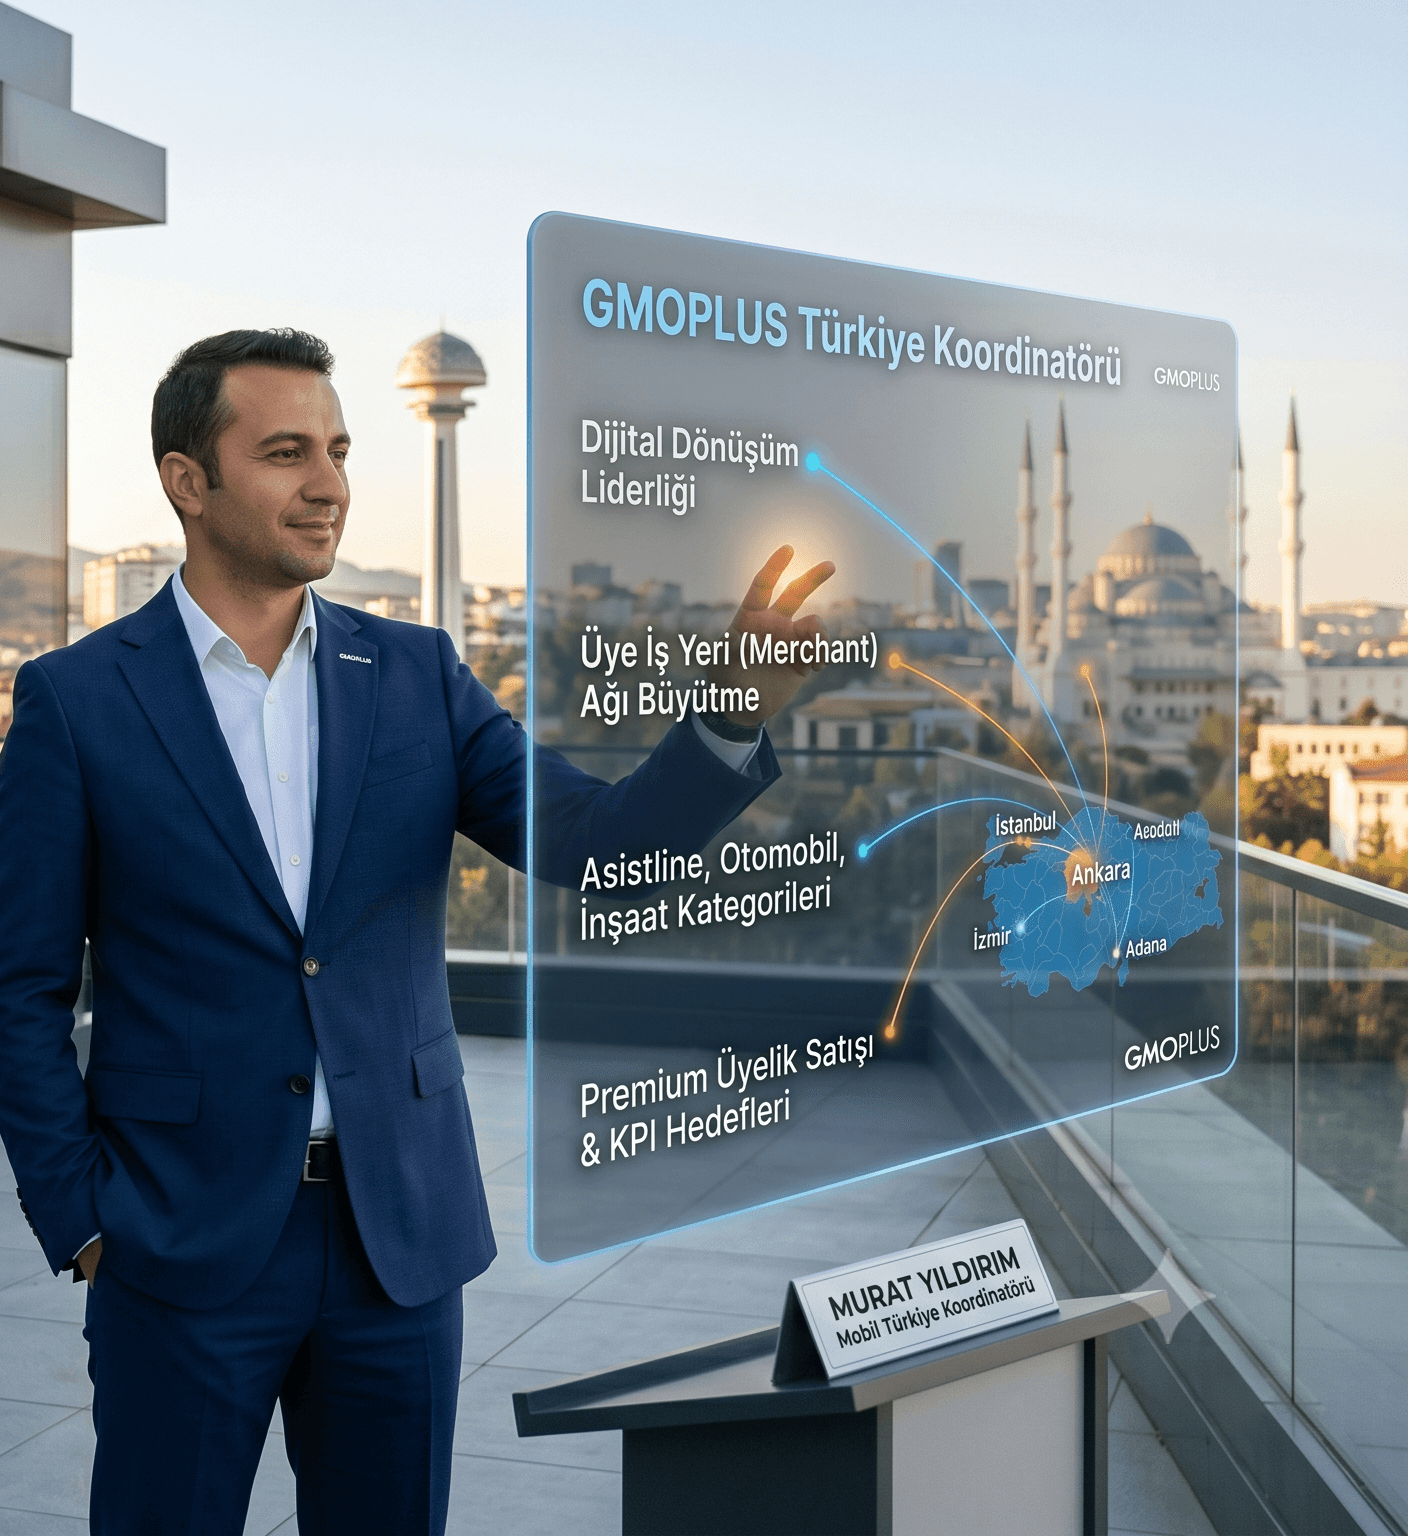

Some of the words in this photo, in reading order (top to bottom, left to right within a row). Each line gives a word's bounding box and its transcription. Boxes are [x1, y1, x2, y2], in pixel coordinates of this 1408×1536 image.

[583, 278, 788, 348] GMOPLUS
[798, 305, 924, 370] Türkiye
[934, 326, 1121, 386] Koordinatörü
[1154, 368, 1220, 392] GMOPLUS
[582, 420, 663, 463] Dijital
[673, 426, 800, 473] Dönüşüm
[582, 469, 696, 516] Liderliği
[581, 626, 637, 676] Üye
[646, 626, 670, 675] İş
[678, 632, 730, 666] Yeri
[740, 631, 878, 670] (Merchant)
[581, 682, 629, 726] Ağı
[639, 680, 760, 722] Büyütme
[996, 811, 1056, 836] İstanbul
[580, 846, 711, 891] Asistline,
[720, 832, 846, 873] Otomobil,
[1072, 862, 1130, 886] Ankara
[580, 898, 669, 946] İnşaat
[678, 879, 831, 932] Kategorileri
[974, 926, 1011, 950] İzmir
[1125, 939, 1167, 958] Adana
[1124, 1026, 1221, 1071] GMOPLUS
[581, 1062, 708, 1118] Premium
[717, 1045, 797, 1098] Üyelik
[806, 1034, 874, 1069] Satışı
[580, 1132, 601, 1168] &
[610, 1120, 657, 1162] KPI
[666, 1090, 790, 1148] Hedefleri
[828, 1275, 913, 1321] MURAT
[917, 1247, 1020, 1293] YILDIRIM
[836, 1318, 881, 1348] Mobil
[882, 1307, 940, 1335] Türkiye
[941, 1276, 1035, 1318] Koordinatörü
